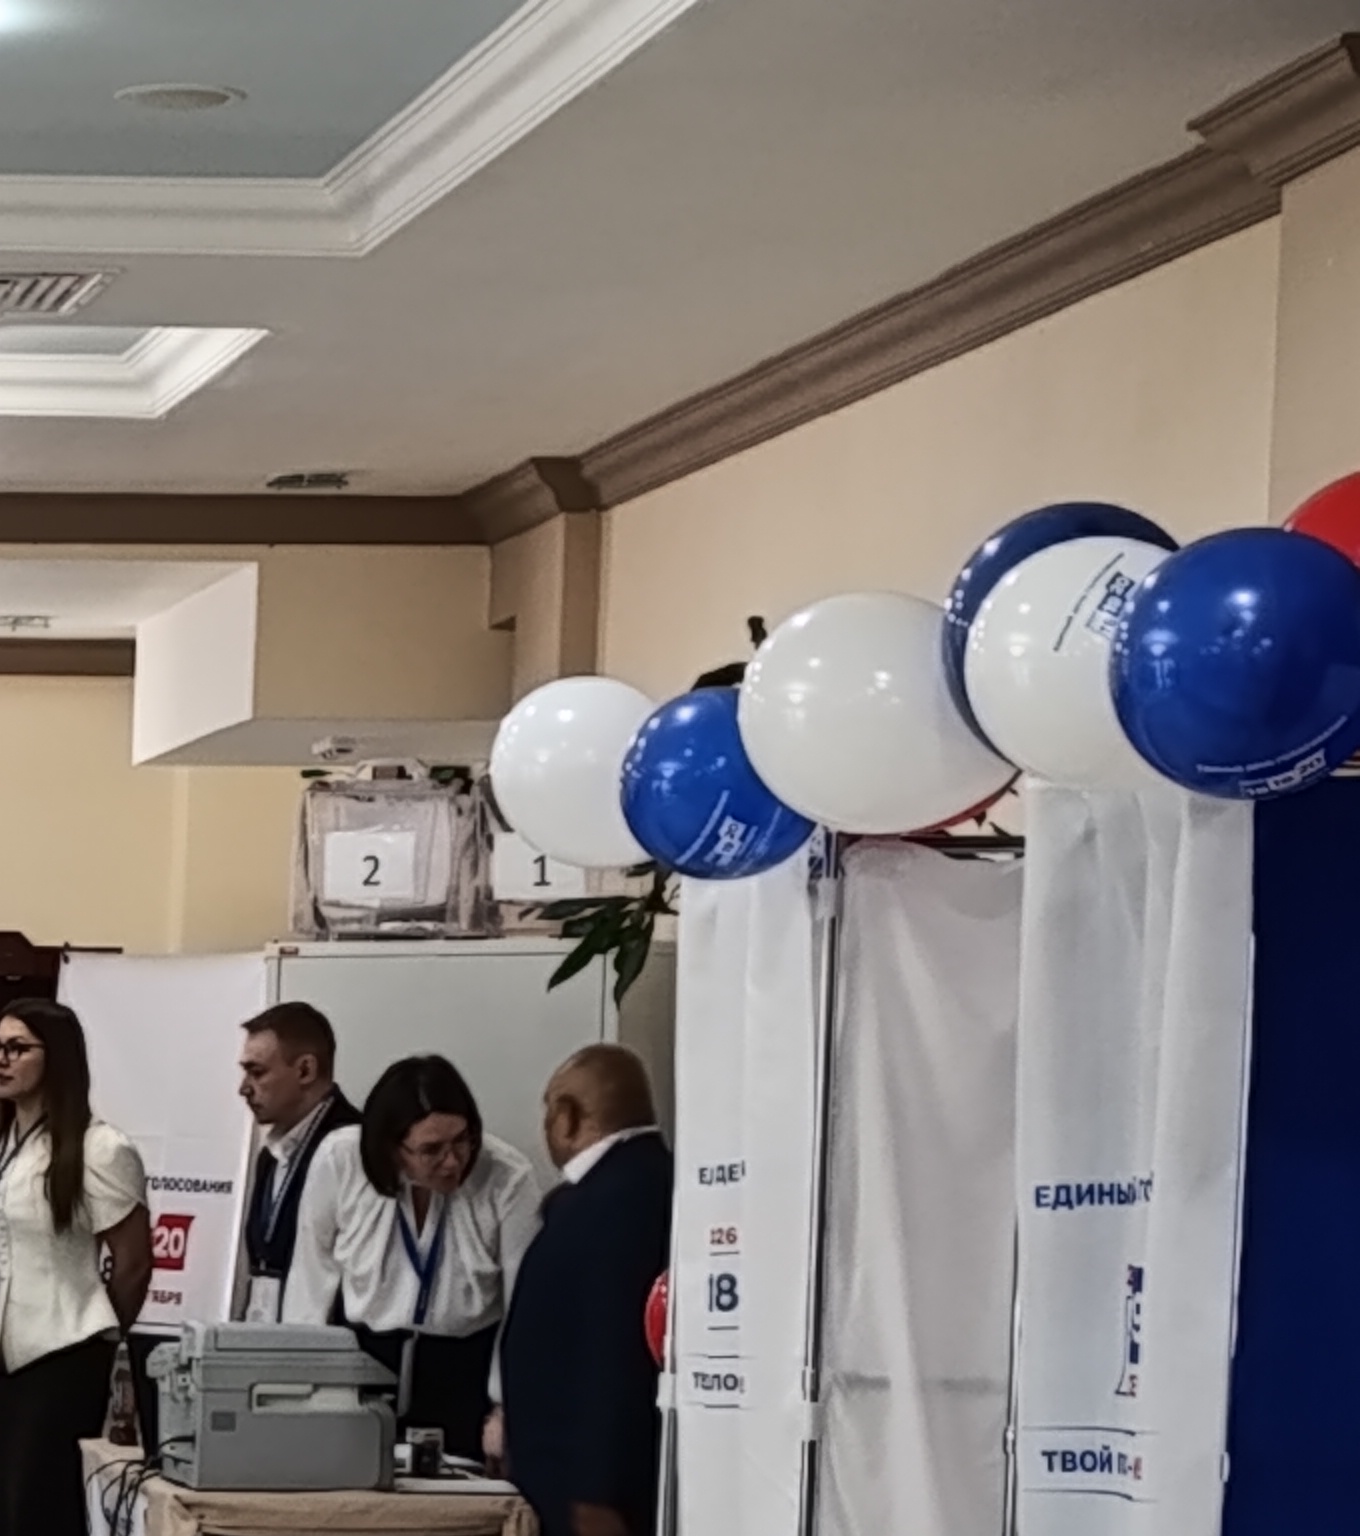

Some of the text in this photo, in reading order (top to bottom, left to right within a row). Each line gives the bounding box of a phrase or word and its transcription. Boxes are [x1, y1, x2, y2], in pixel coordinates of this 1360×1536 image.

[361, 855, 381, 887] 2
[532, 854, 552, 886] 1
[152, 1225, 186, 1259] 20
[1041, 1444, 1113, 1475] ТВОЙ
